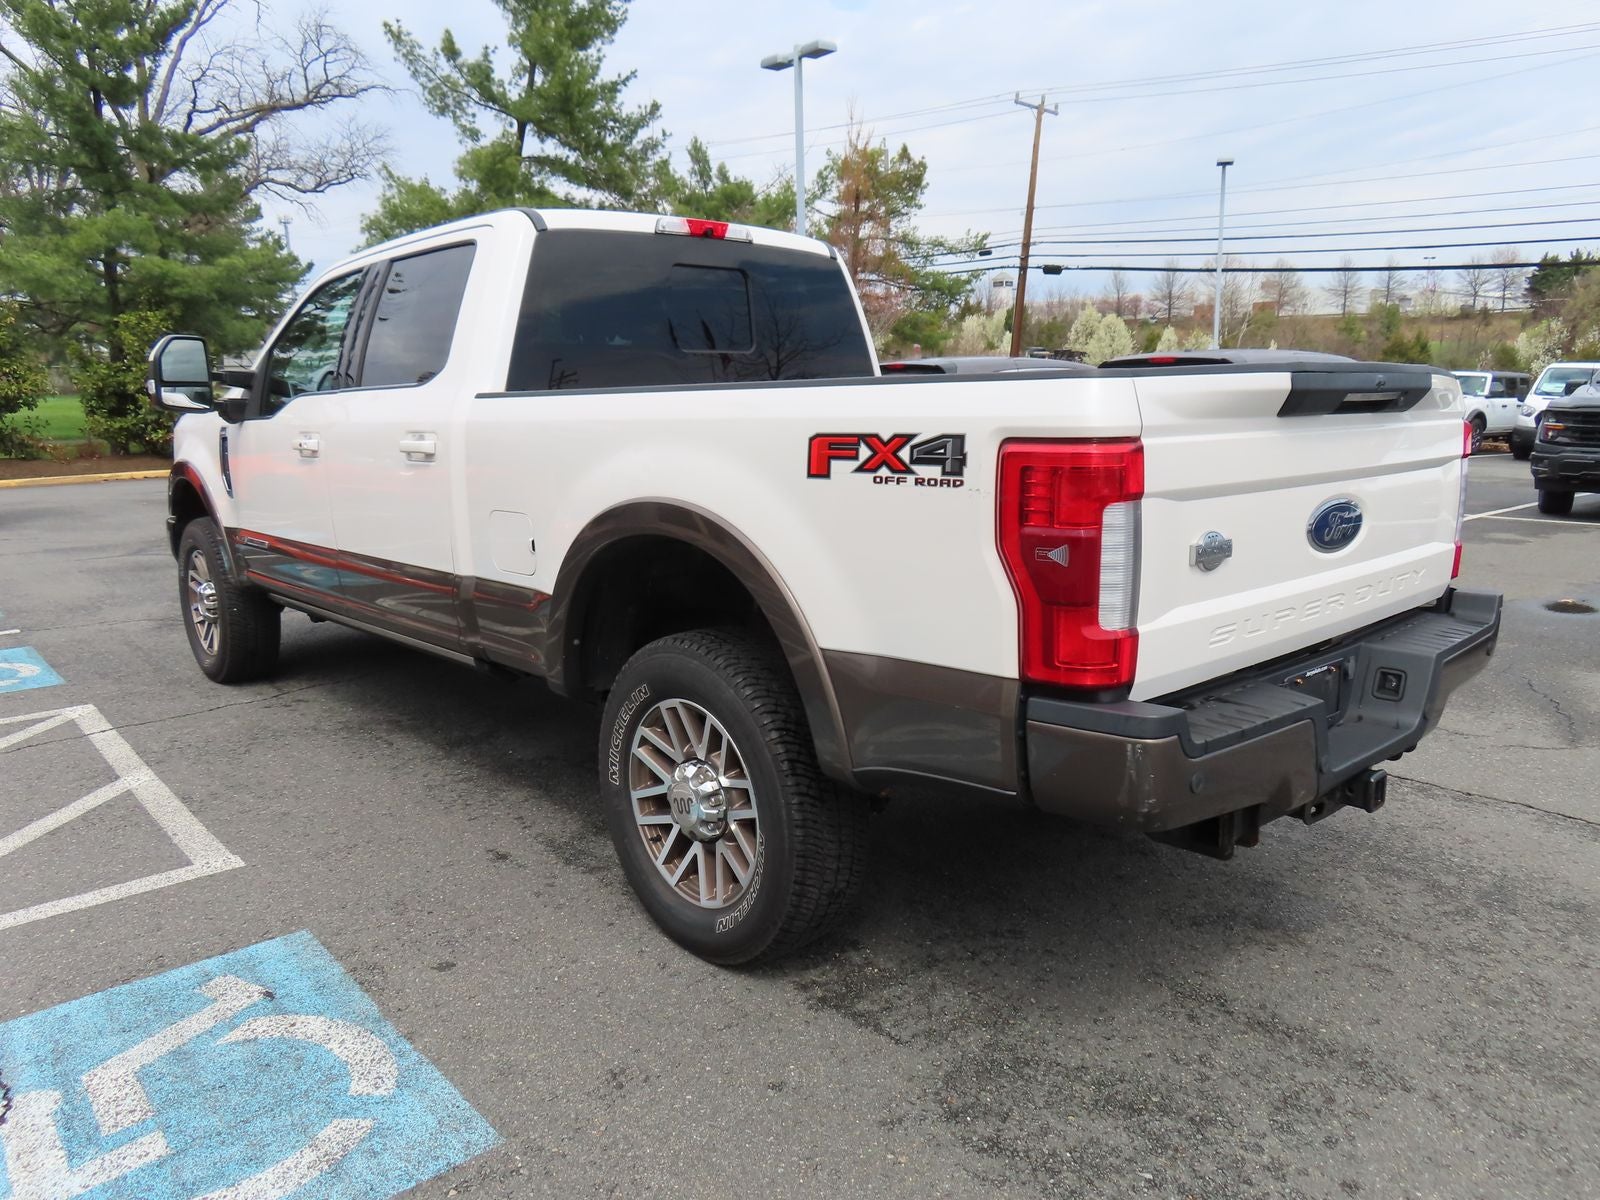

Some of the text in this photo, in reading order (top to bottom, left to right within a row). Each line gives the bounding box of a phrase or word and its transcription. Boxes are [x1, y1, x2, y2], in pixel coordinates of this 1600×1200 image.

[807, 433, 967, 479] FX4
[873, 475, 964, 488] OFF ROAD
[1209, 568, 1426, 648] SUPER DUTY
[609, 684, 650, 785] MICHELIN
